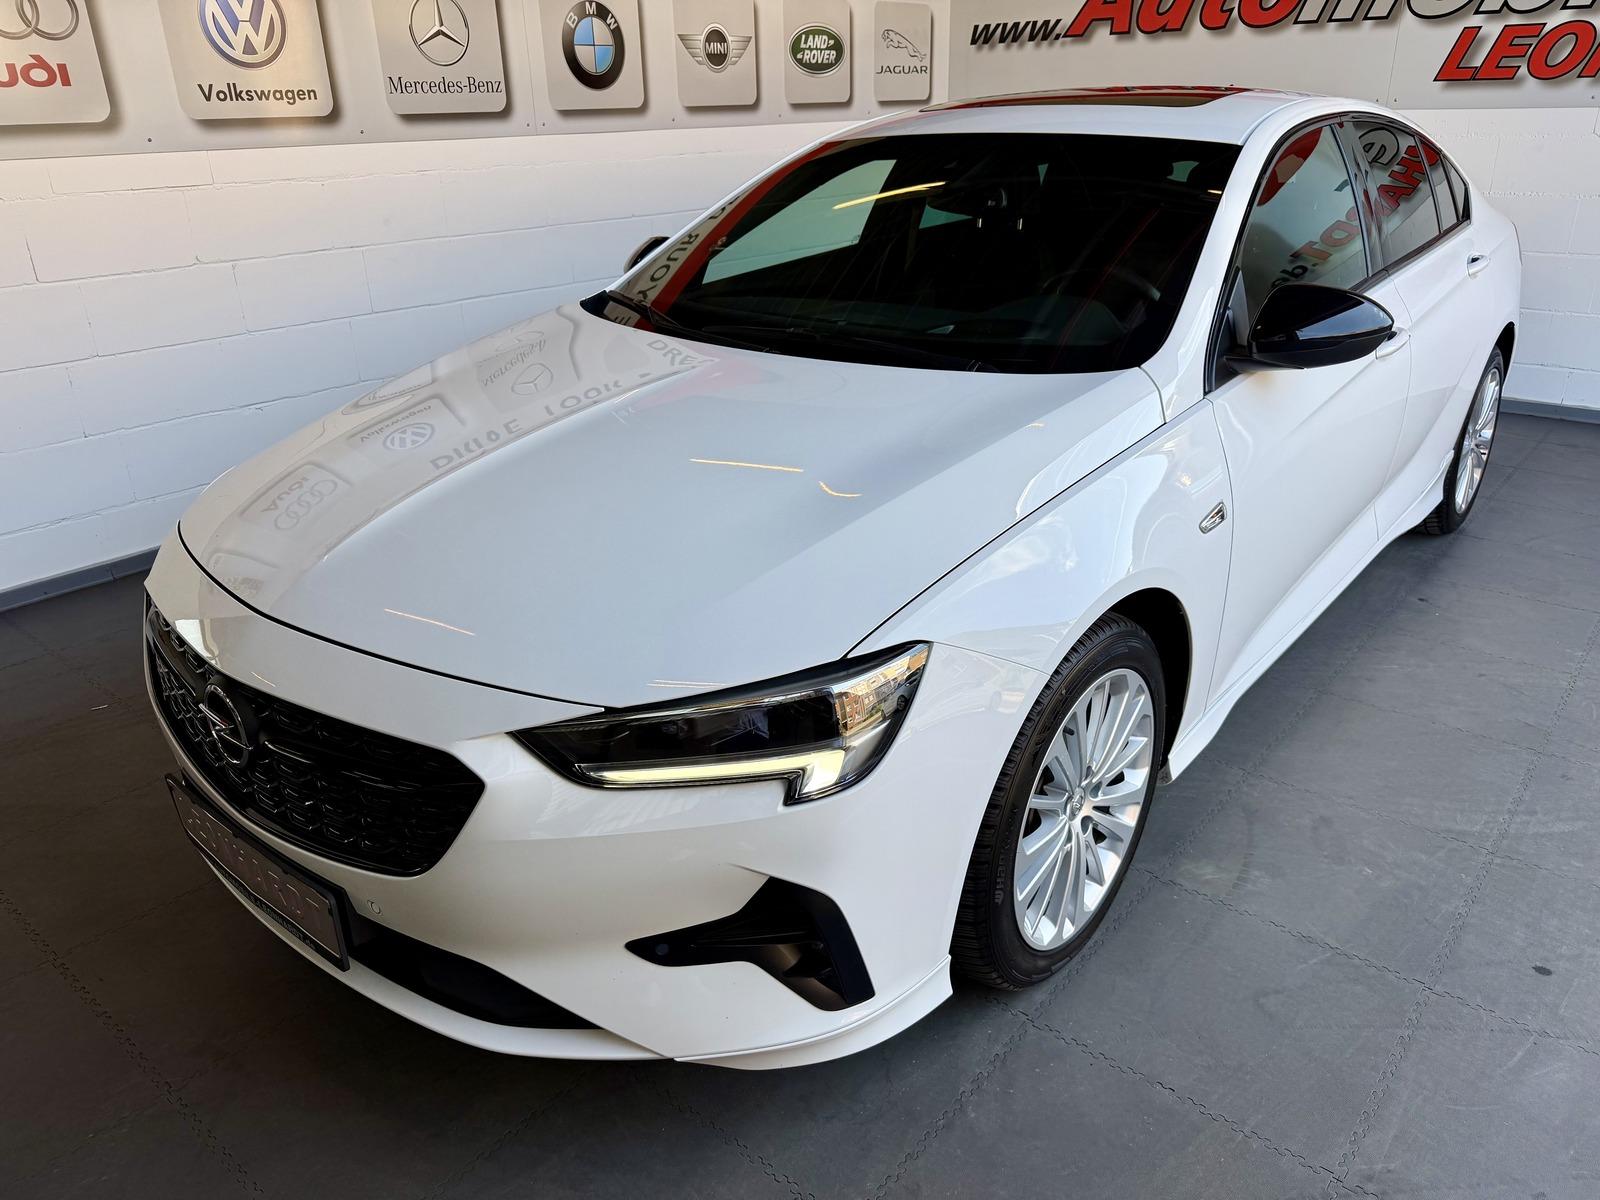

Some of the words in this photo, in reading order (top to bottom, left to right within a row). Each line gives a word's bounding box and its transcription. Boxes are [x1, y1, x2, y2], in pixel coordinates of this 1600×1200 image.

[705, 40, 728, 55] MINI
[875, 65, 929, 75] JAGUAR
[197, 82, 319, 105] Volkswagen
[388, 76, 503, 95] Mercedes-Benz
